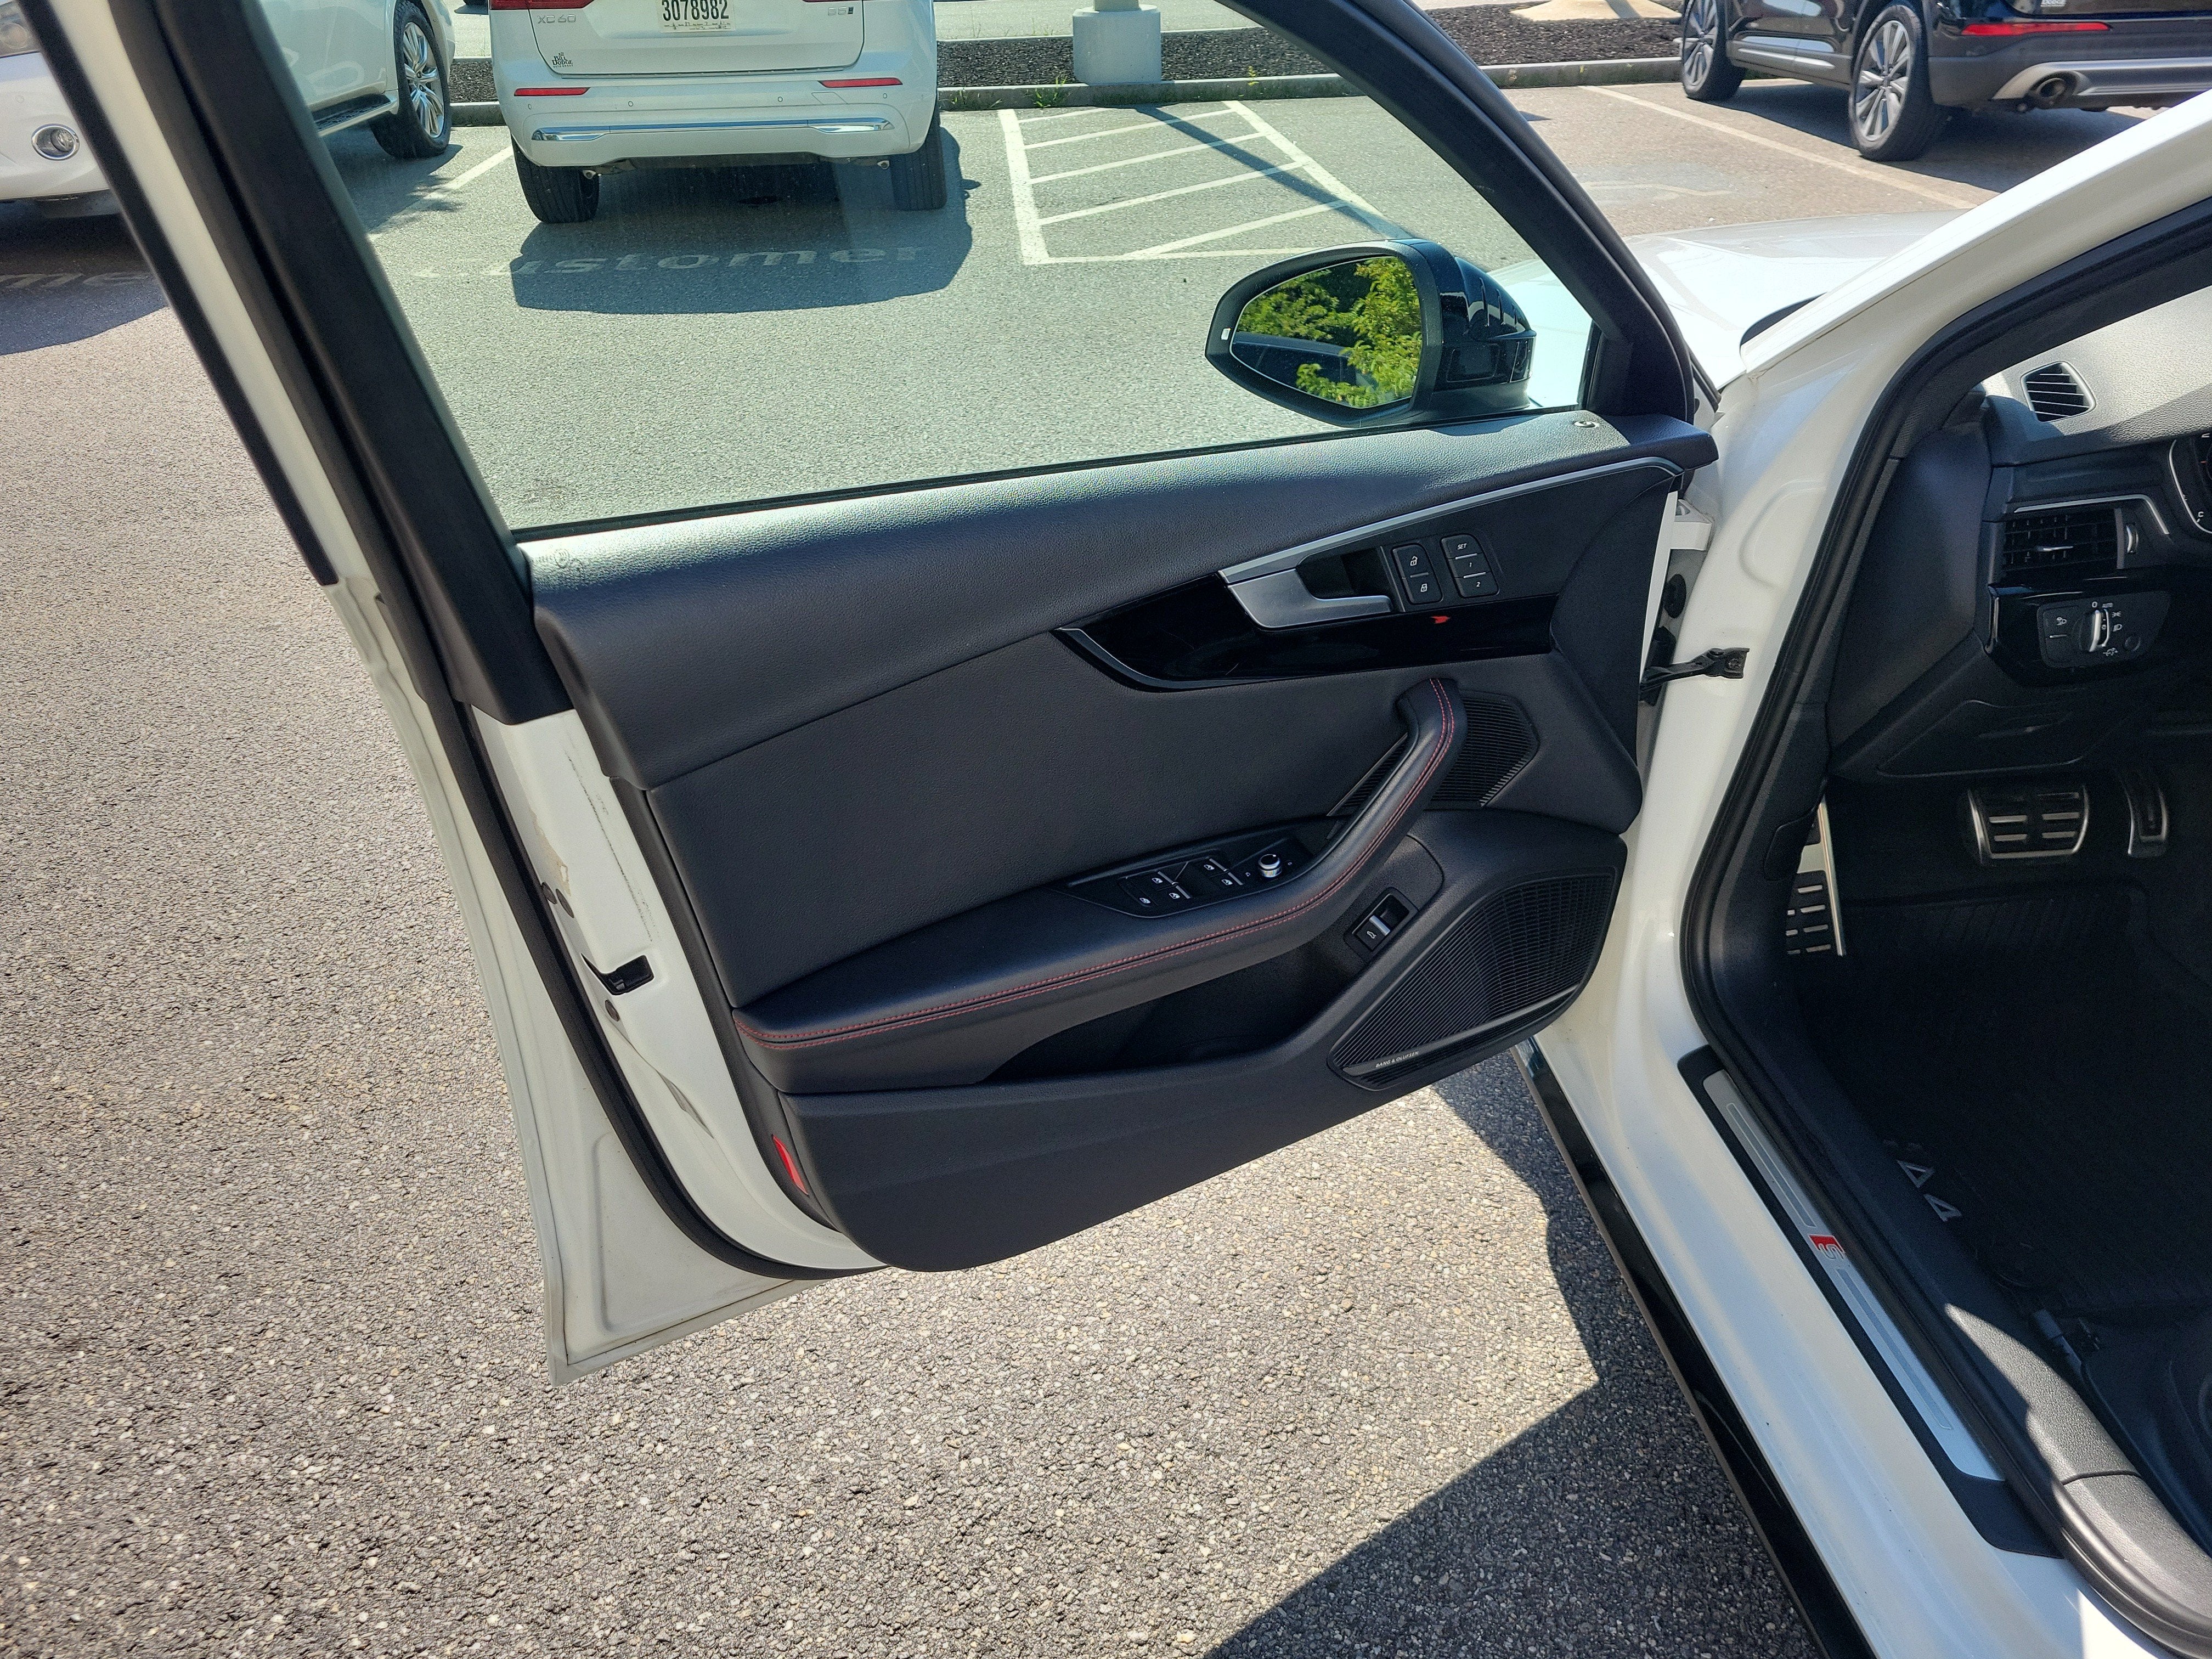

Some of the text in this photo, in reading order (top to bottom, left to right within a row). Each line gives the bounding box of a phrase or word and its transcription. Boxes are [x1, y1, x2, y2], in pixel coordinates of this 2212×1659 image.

[538, 14, 576, 24] XC60
[662, 0, 729, 21] 3078982
[1375, 1059, 1391, 1068] BANG
[1396, 1051, 1419, 1061] OLUFSEN
